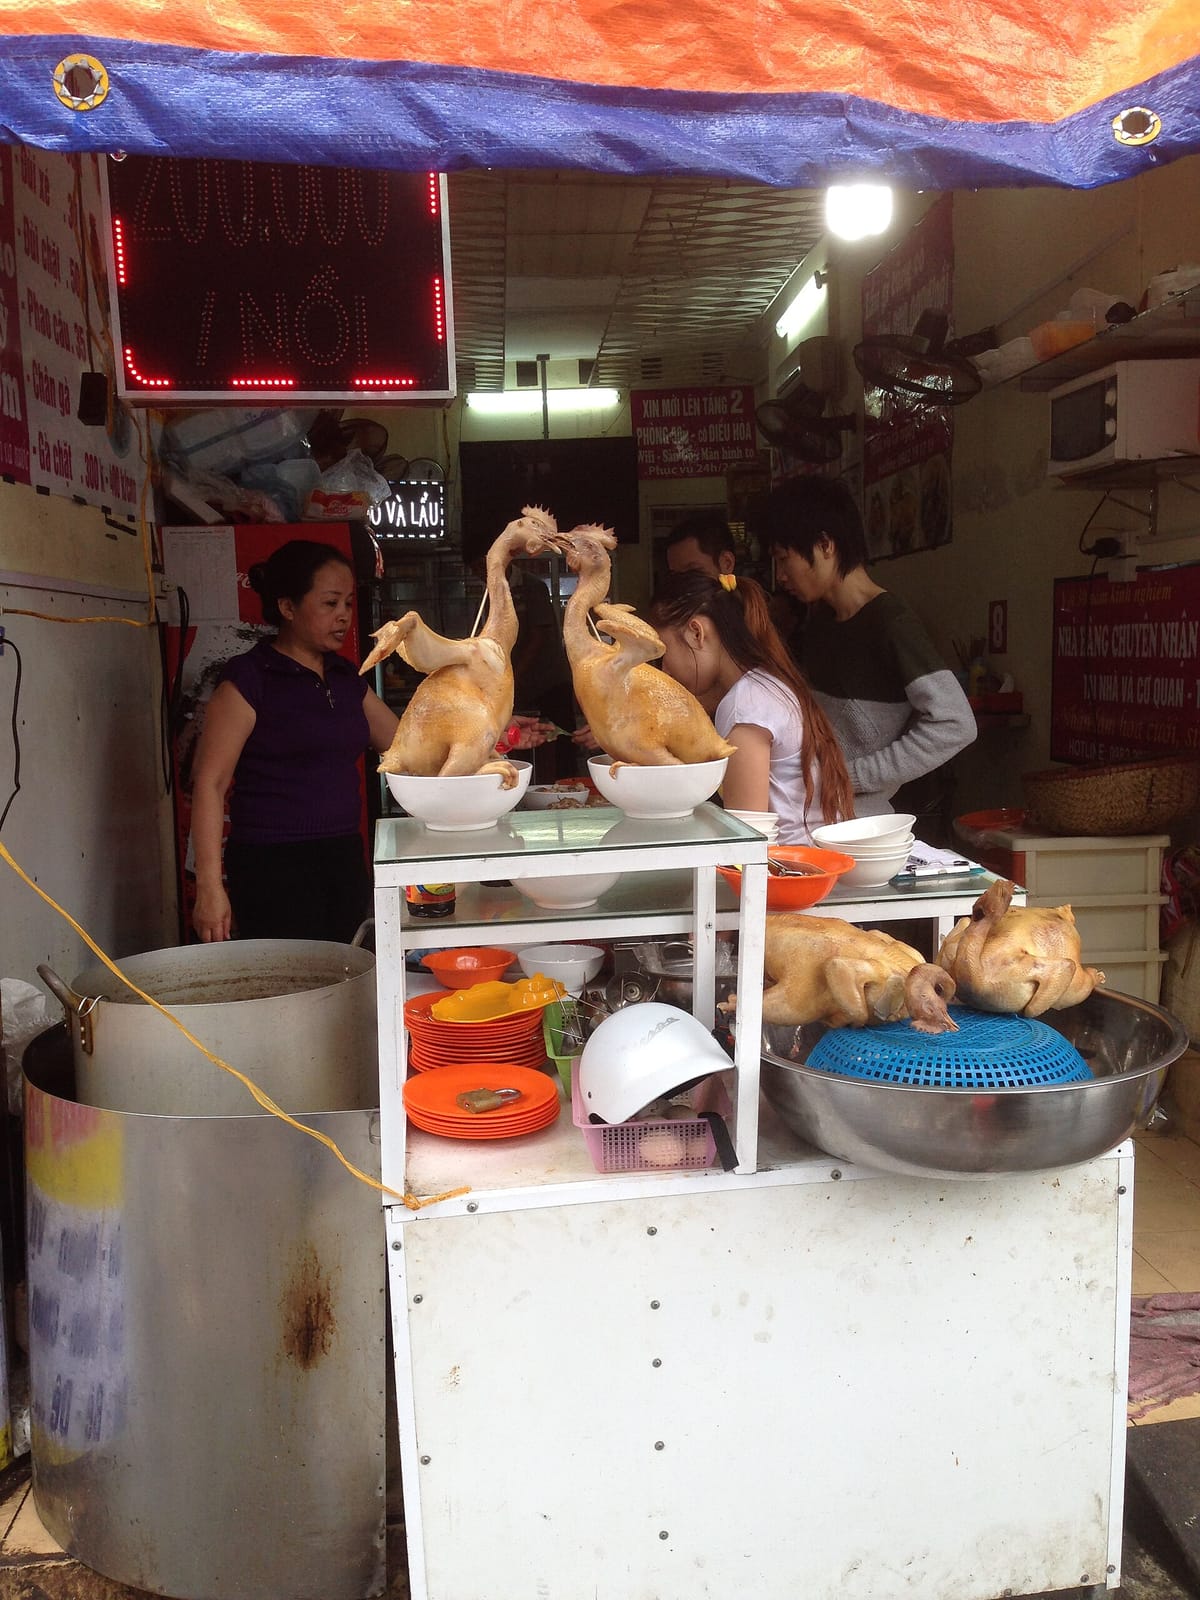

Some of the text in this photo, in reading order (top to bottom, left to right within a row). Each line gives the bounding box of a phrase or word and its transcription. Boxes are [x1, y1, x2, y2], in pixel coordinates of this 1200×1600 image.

[642, 399, 660, 418] XIN
[730, 389, 744, 414] 2
[385, 494, 407, 528] VÀ
[1111, 610, 1158, 658] CHUYÊN
[1153, 676, 1184, 708] QUAN
